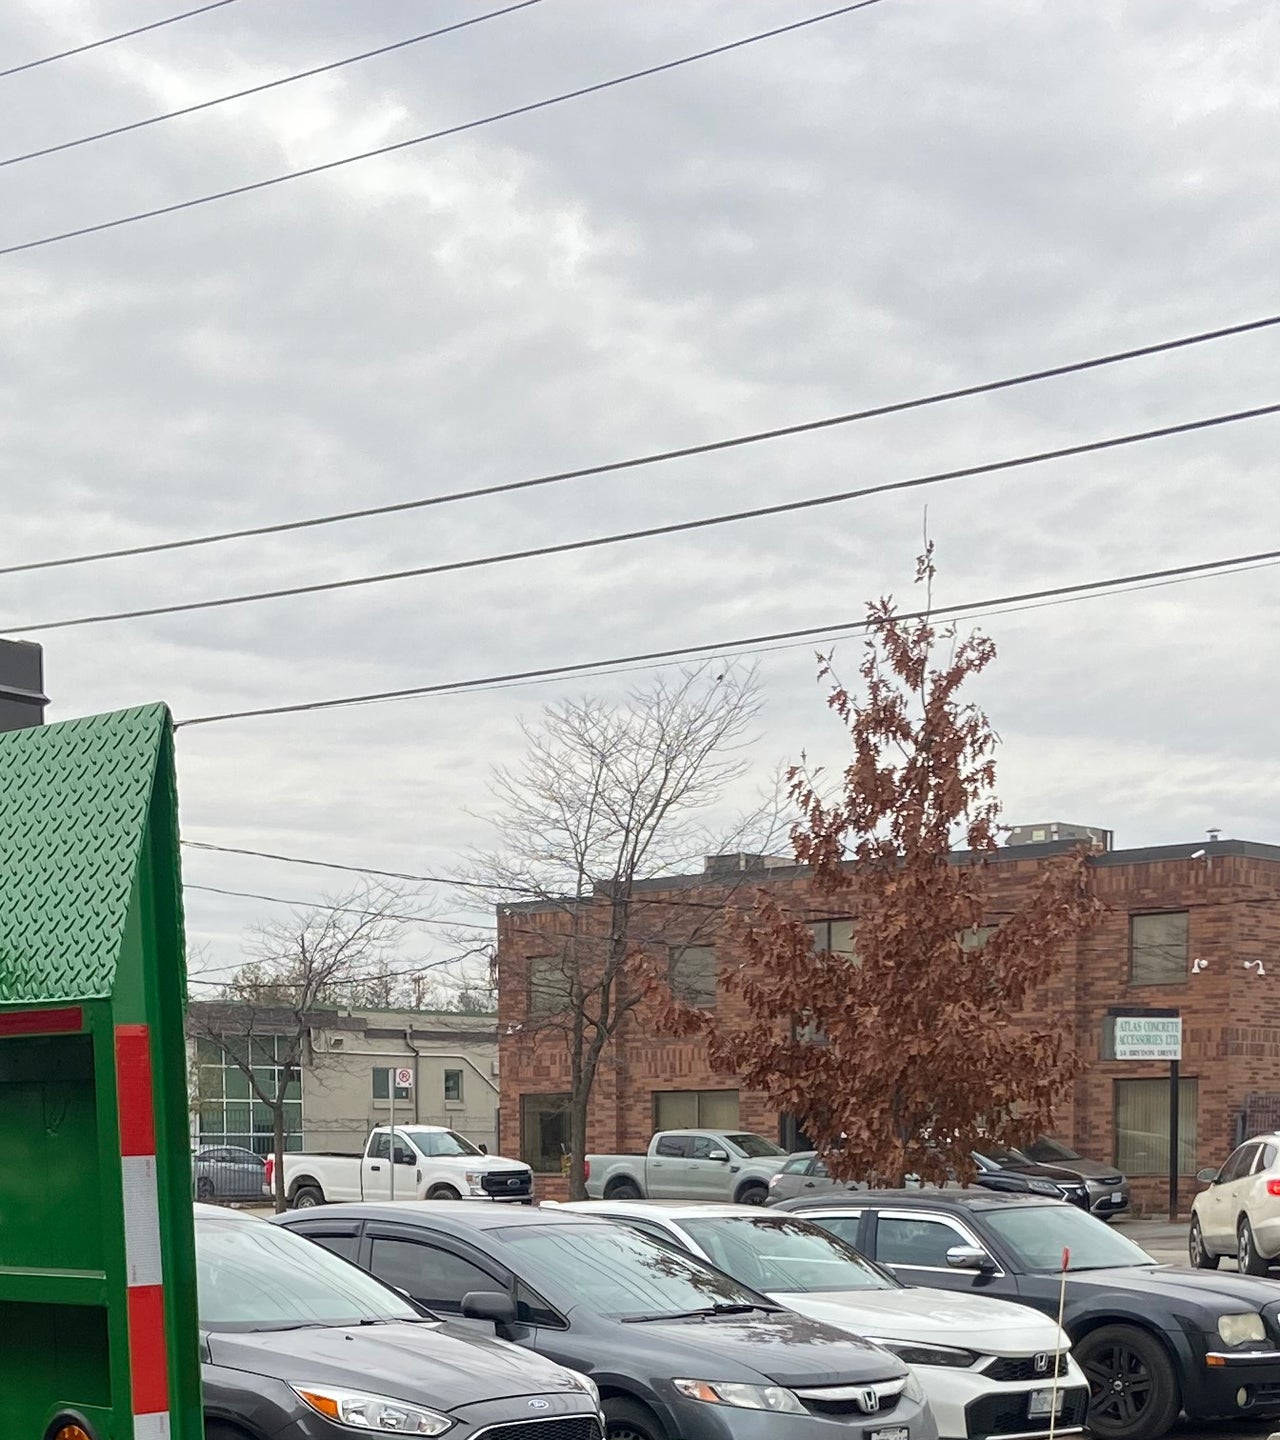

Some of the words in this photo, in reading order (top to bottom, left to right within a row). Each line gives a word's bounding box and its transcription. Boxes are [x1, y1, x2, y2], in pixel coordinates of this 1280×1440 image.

[1119, 1021, 1143, 1033] ATLAS
[1143, 1021, 1179, 1033] CONCRETE
[1118, 1034, 1164, 1046] ACCESSORIES
